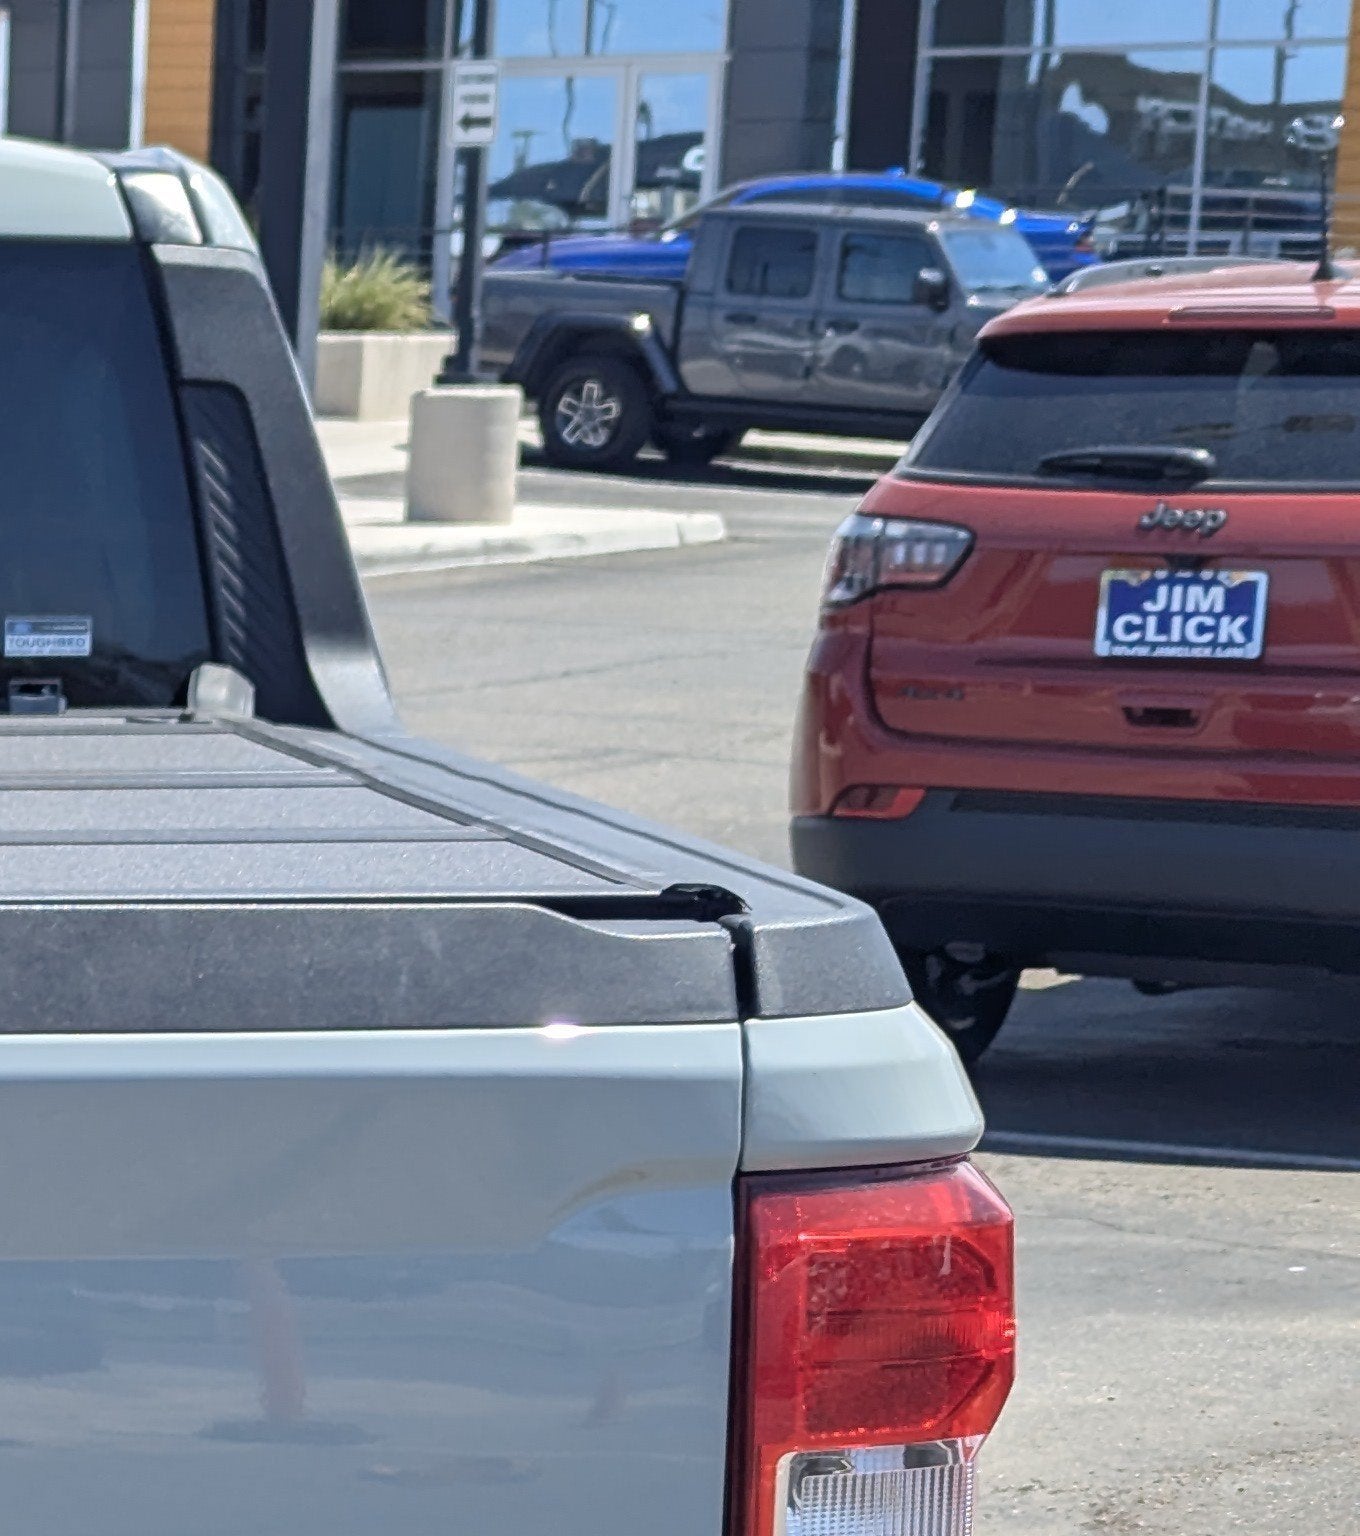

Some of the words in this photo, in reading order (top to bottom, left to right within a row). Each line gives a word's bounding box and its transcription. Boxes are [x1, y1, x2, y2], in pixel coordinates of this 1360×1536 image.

[1138, 499, 1227, 538] Jeep
[1141, 583, 1226, 614] JIM
[1112, 614, 1249, 645] CLICK
